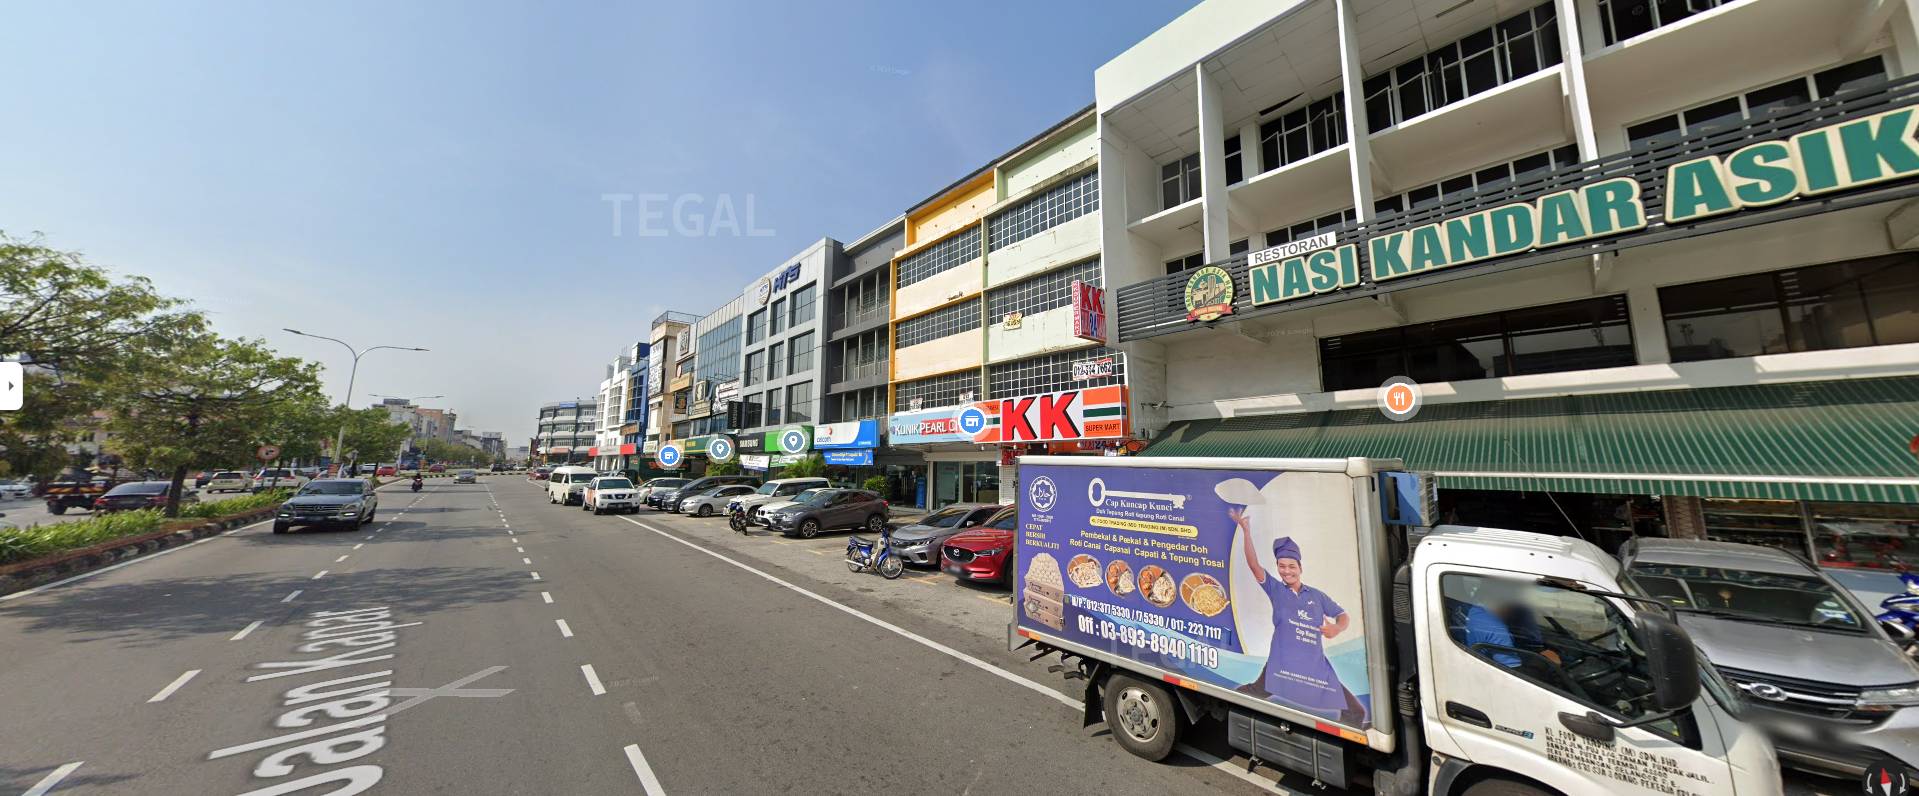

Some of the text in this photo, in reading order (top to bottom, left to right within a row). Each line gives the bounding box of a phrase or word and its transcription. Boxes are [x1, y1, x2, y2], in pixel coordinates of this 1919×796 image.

[1251, 107, 1919, 304] NASI KANDAR ASIK
[1253, 234, 1330, 265] RESTORAN
[1080, 282, 1104, 315] KK
[920, 421, 947, 434] PEARL
[1003, 391, 1082, 440] KK
[1105, 499, 1119, 509] Cap
[1149, 501, 1173, 512] Kunci
[1025, 523, 1043, 531] CEPAT
[1025, 531, 1046, 540] BERSIH
[1025, 539, 1060, 550] BERKUALITI
[1069, 538, 1082, 547] Roti
[1083, 540, 1101, 550] Canai
[1134, 548, 1159, 560] Capati
[1161, 551, 1167, 560] &
[1169, 552, 1200, 567] Tepung
[1202, 557, 1225, 569] Tosai
[1080, 530, 1111, 542] Pembekal
[1143, 538, 1150, 546] &
[1151, 539, 1189, 553] Pengedar
[1190, 545, 1208, 554] Doh
[1111, 605, 1131, 620] 5330
[1143, 612, 1164, 627] 5330
[1188, 621, 1203, 636] 223
[1205, 626, 1222, 640] 7117
[1188, 644, 1218, 669] 1119
